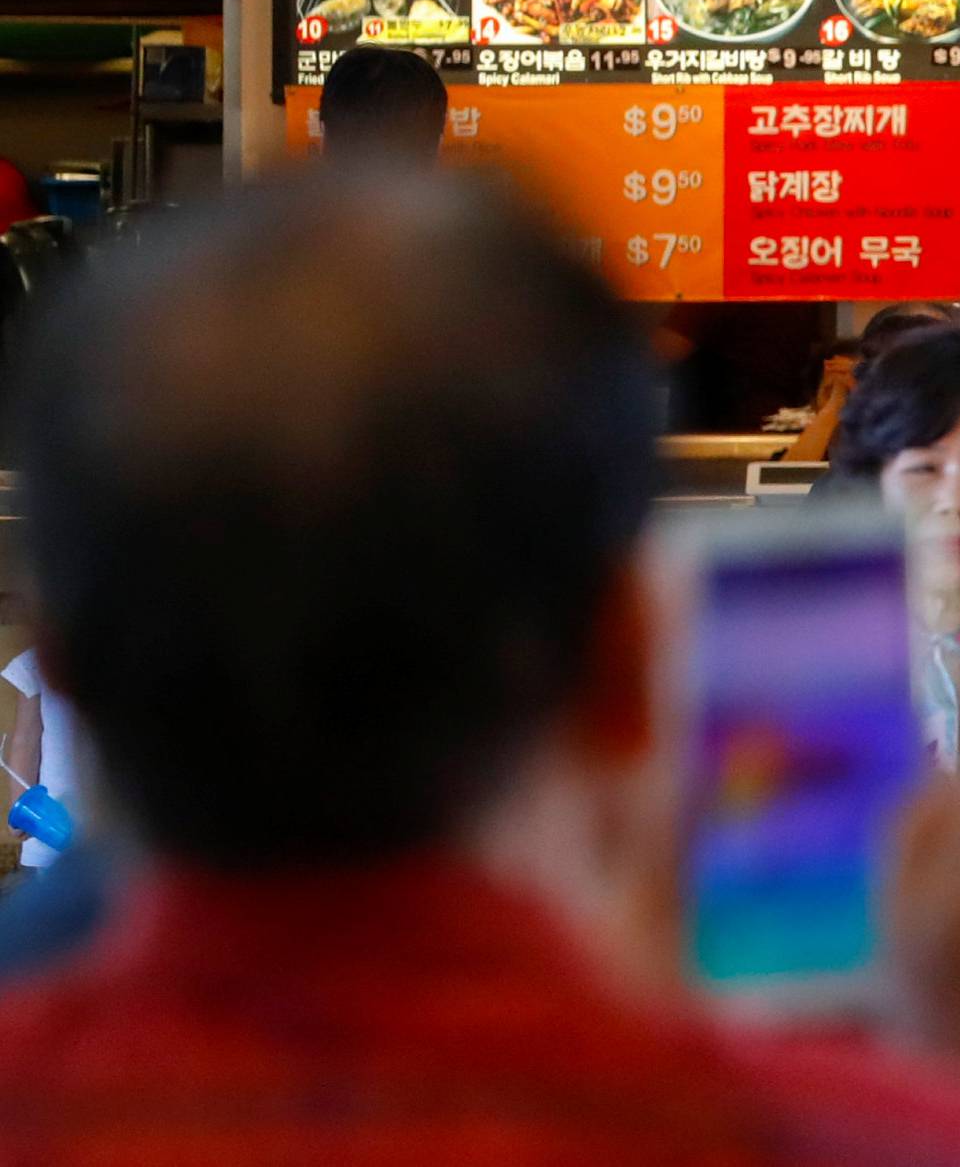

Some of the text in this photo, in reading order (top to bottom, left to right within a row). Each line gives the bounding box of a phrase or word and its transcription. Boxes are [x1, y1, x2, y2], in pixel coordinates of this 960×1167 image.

[299, 51, 346, 71] 군만
[299, 73, 324, 85] Fried
[748, 104, 907, 137] 고추장찌개
[748, 170, 842, 203] 닭계장
[748, 236, 843, 270] 오징어
[860, 236, 922, 268] 무국
